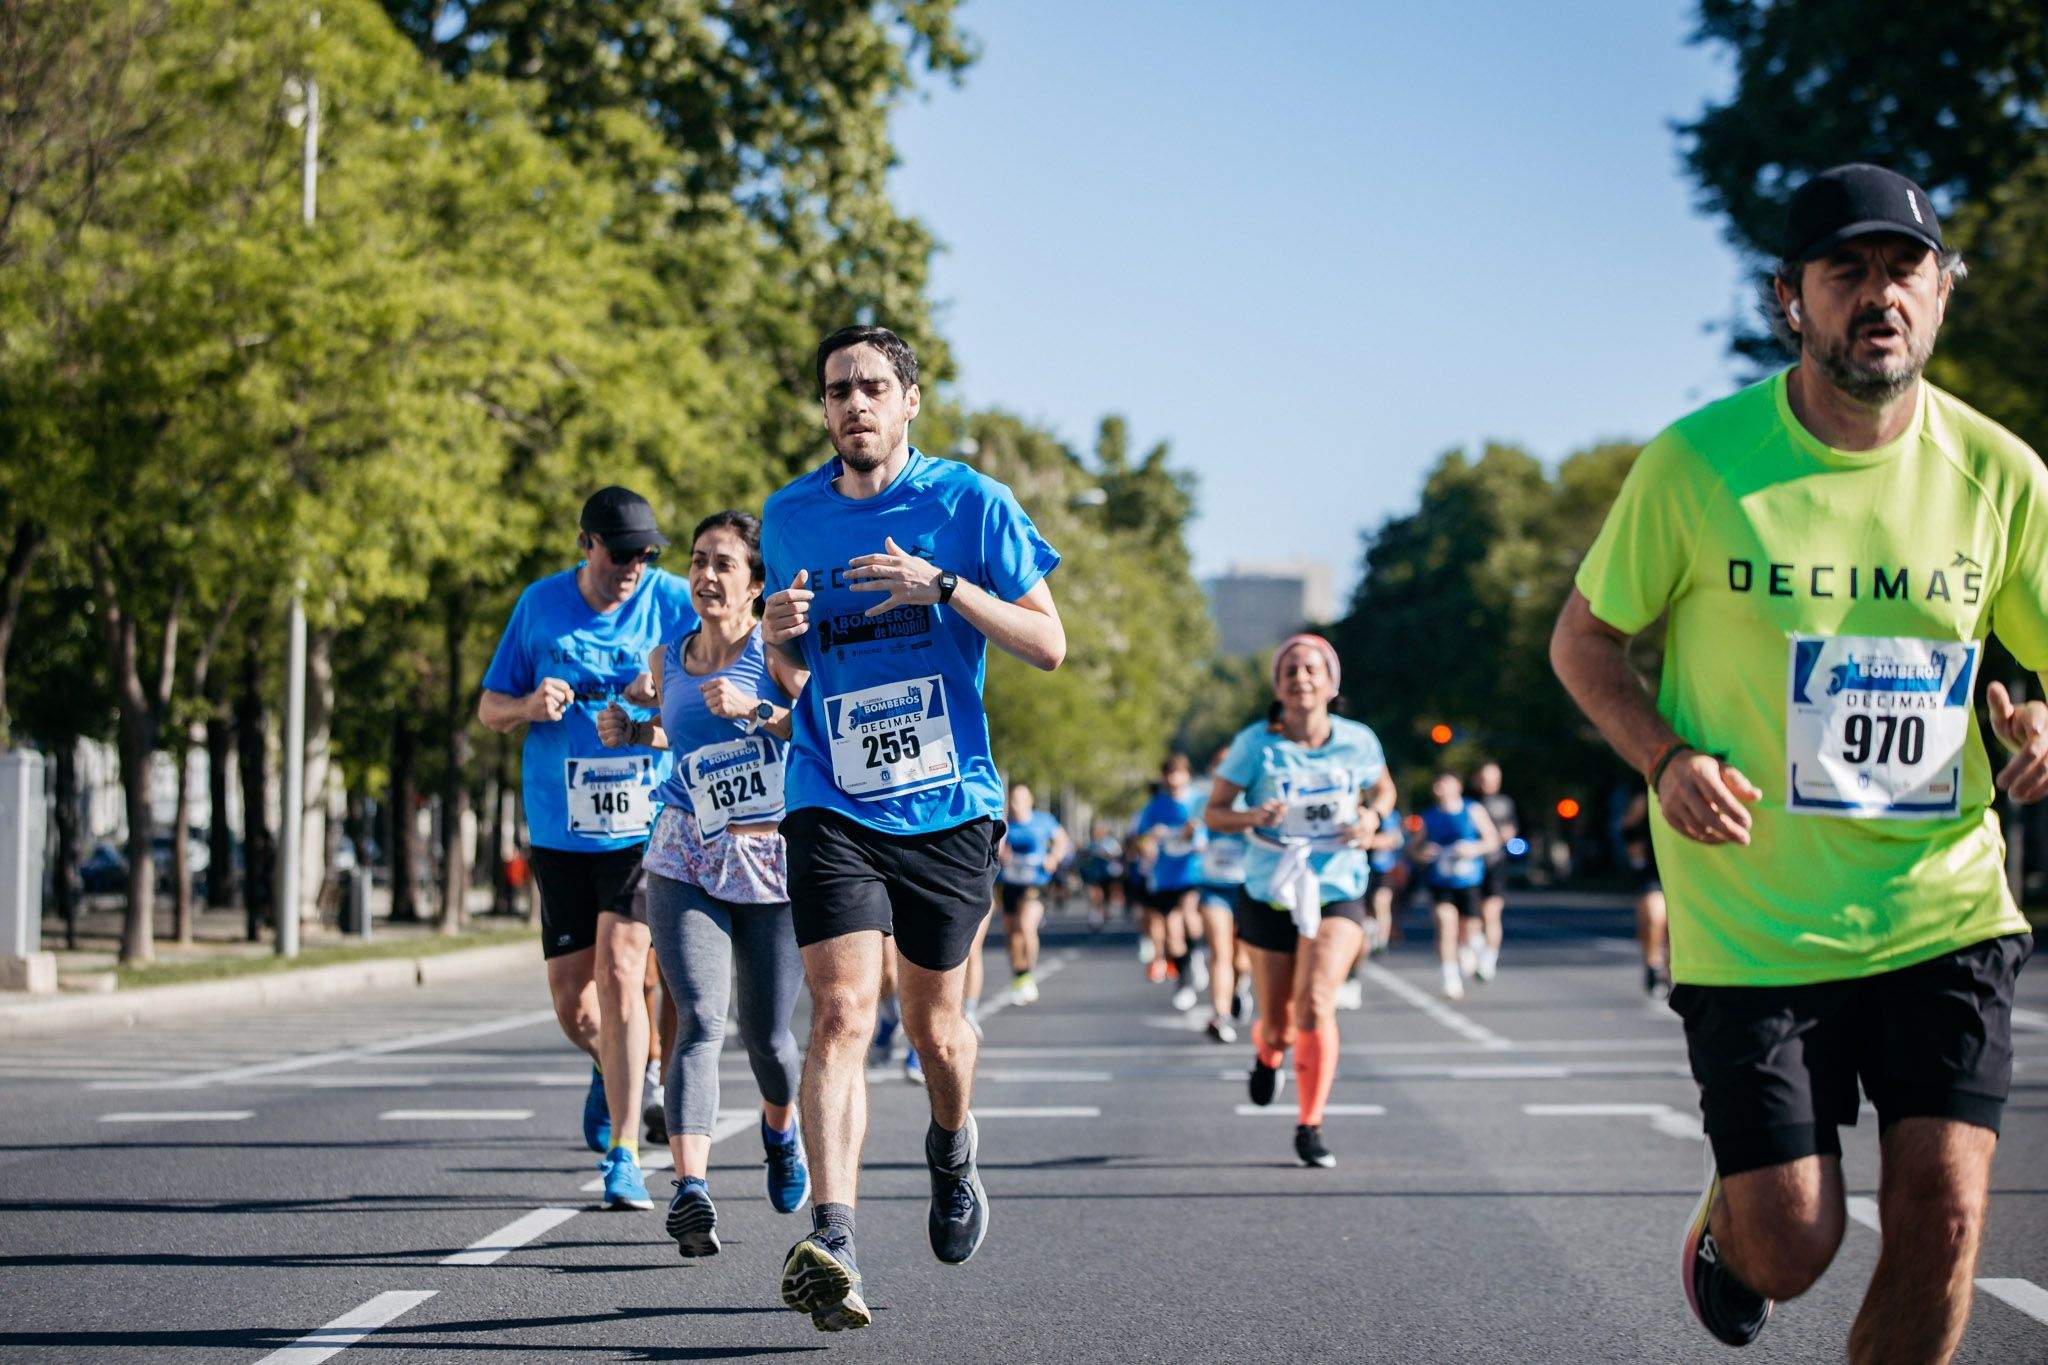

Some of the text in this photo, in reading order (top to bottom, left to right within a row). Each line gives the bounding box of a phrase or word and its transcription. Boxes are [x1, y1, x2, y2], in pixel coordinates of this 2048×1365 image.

[1728, 560, 1982, 604] DECIMAS
[864, 694, 921, 714] BOMBEROS
[1846, 692, 1937, 709] DECIMAS
[861, 713, 922, 734] DECIMAS
[862, 726, 921, 769] 255
[1842, 714, 1925, 765] 970
[707, 760, 760, 782] DECIMAS
[707, 770, 767, 811] 1324
[590, 791, 629, 815] 146
